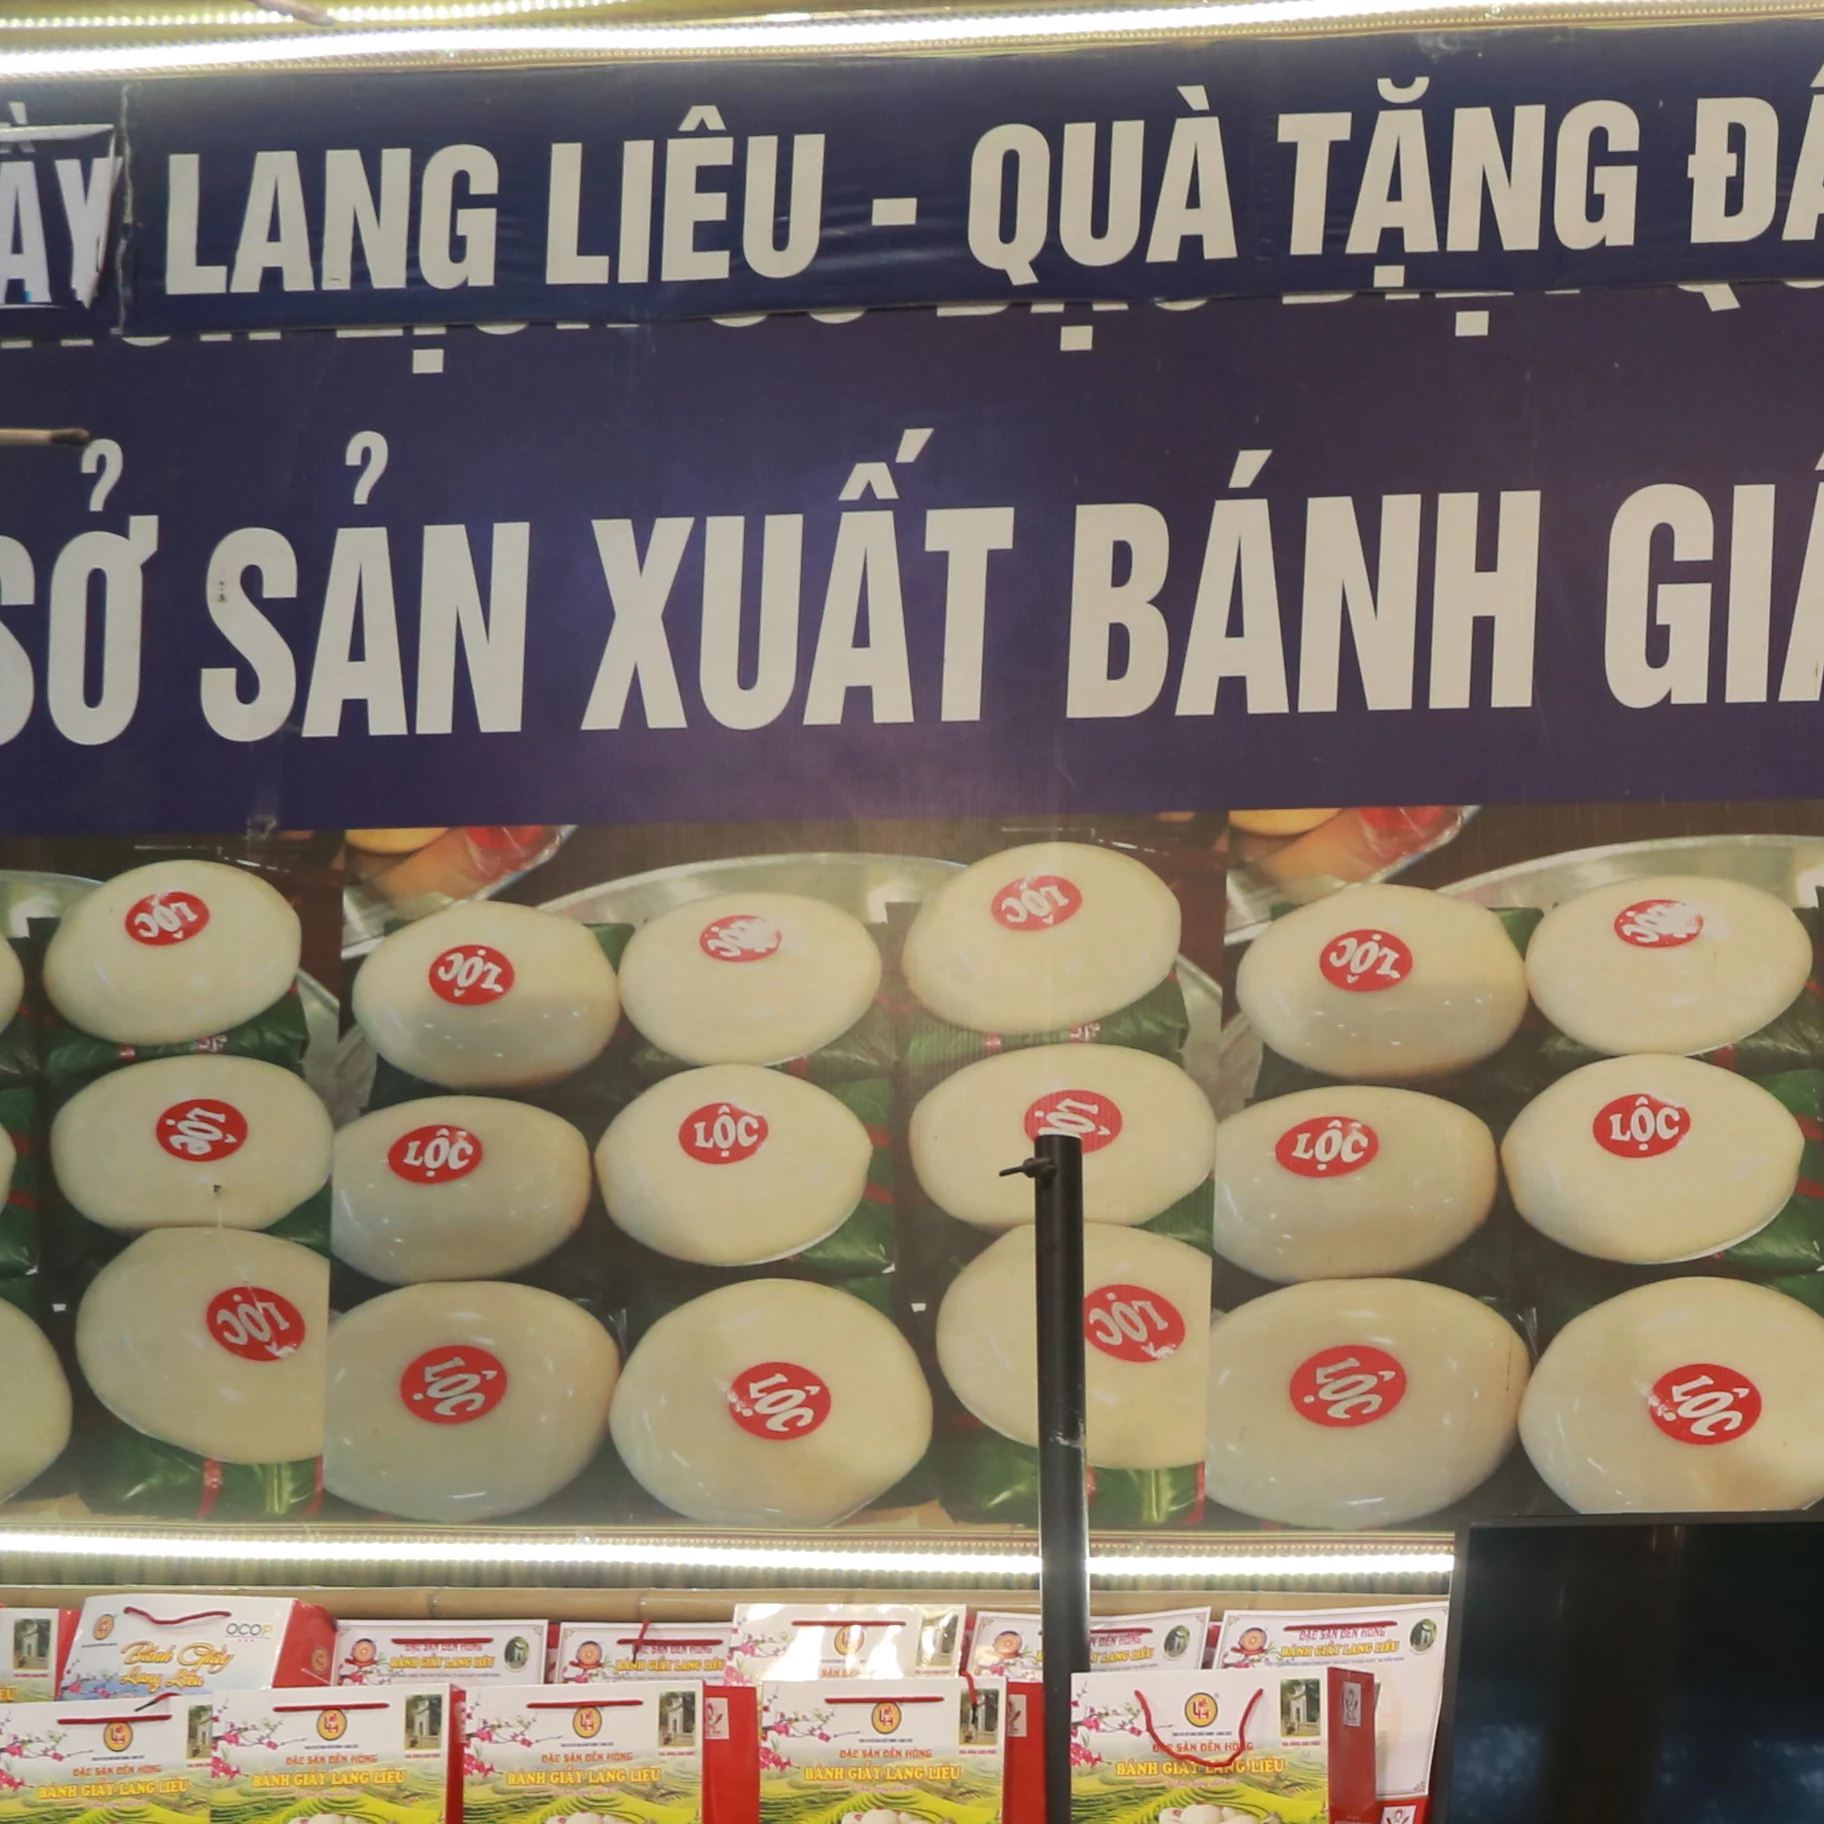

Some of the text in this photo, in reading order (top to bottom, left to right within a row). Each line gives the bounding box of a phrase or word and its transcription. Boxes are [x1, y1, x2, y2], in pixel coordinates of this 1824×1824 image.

[166, 144, 498, 294] LANG
[546, 105, 825, 284] LIÊU
[872, 198, 917, 226] -
[968, 85, 1237, 285] QUÀ
[1278, 77, 1639, 287] TẶNG
[201, 431, 530, 741] SẢN
[581, 428, 1014, 730] XUẤT
[1066, 450, 1541, 718] BÁNH
[134, 895, 198, 943] LỘC
[437, 949, 504, 1001] LỘC
[1329, 933, 1401, 988] LỘC
[693, 1102, 760, 1158] LỘC
[1291, 1117, 1369, 1171] LỘC
[1609, 1093, 1681, 1151] LỘC
[403, 1125, 474, 1178] LỘC
[412, 1357, 497, 1417] LỘC
[731, 1373, 821, 1432] LỘC
[1303, 1357, 1396, 1420] LỘC
[1651, 1375, 1750, 1437] LỘC
[225, 1621, 272, 1637] OCOP
